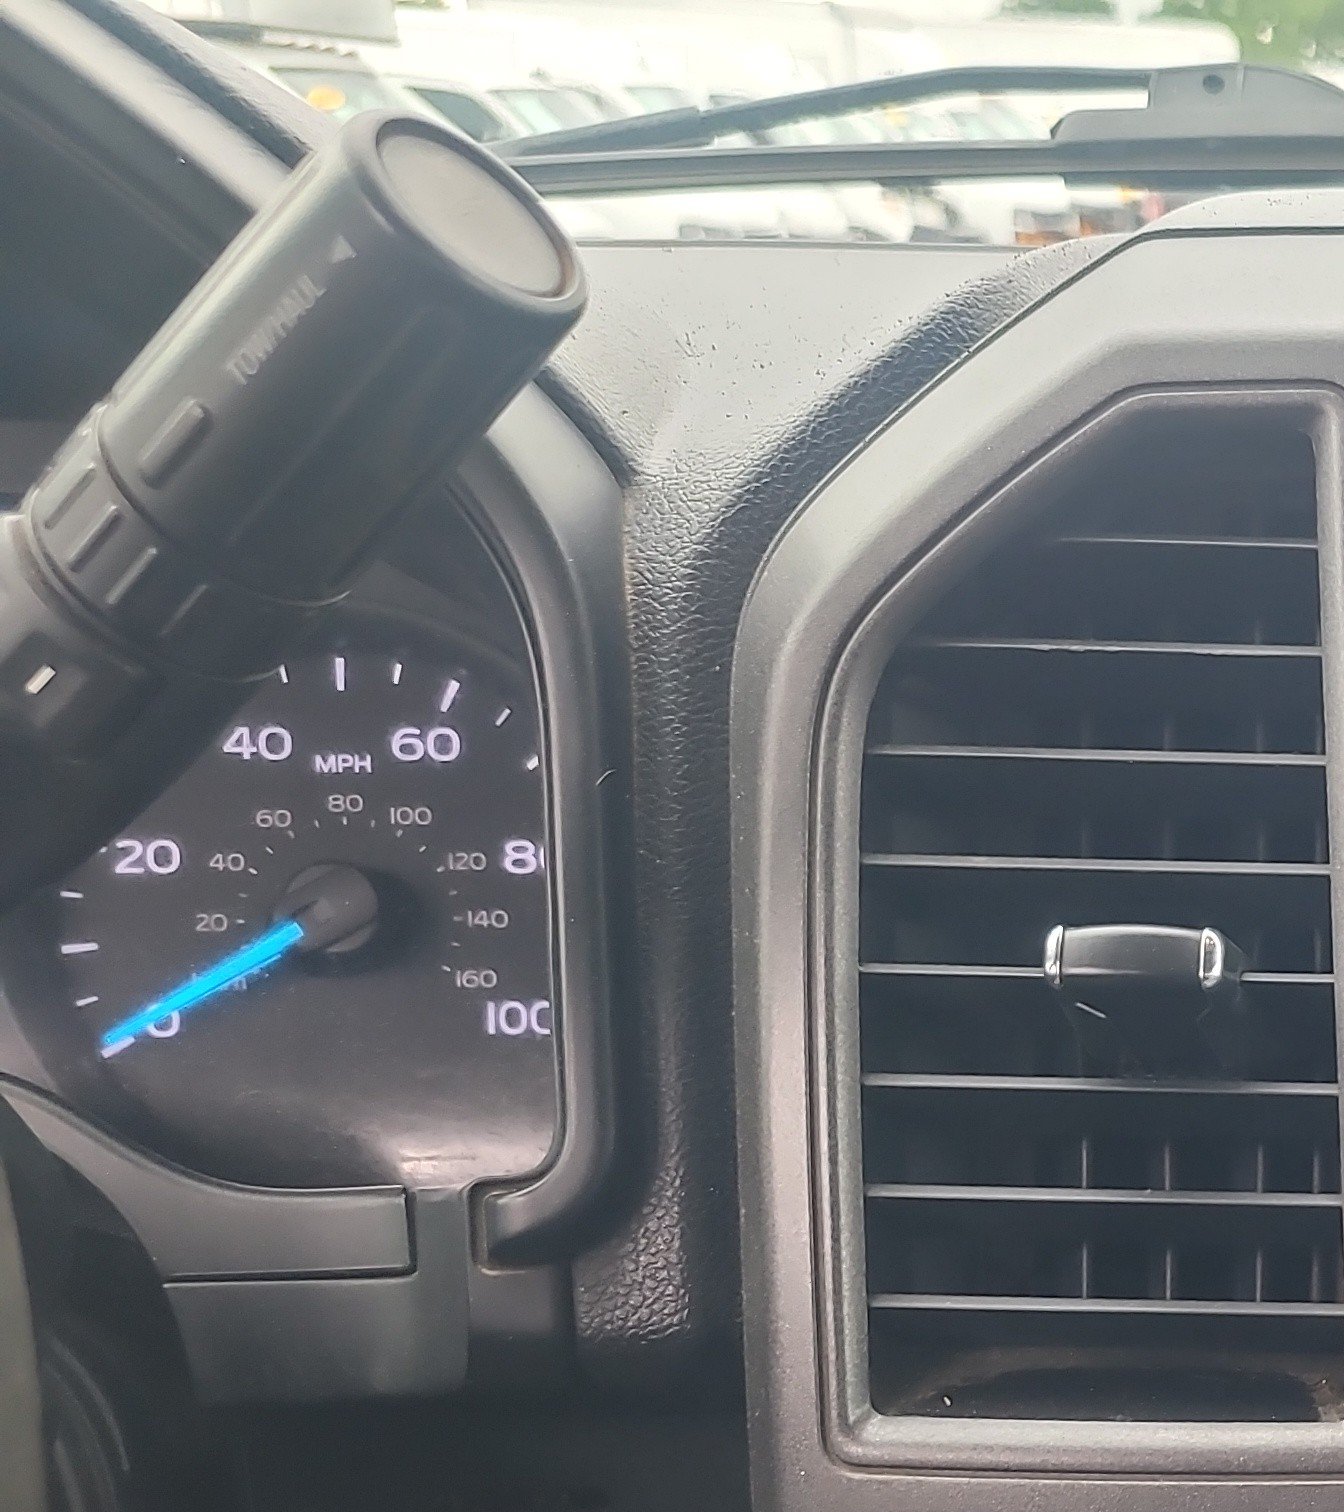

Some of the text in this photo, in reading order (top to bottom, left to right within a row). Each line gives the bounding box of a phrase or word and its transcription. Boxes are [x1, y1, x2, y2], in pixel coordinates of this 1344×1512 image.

[222, 726, 293, 762] 40
[390, 726, 462, 763] 60
[314, 753, 373, 774] MPH
[327, 794, 364, 813] 80
[255, 809, 293, 829] 60
[389, 806, 432, 826] 100
[114, 839, 181, 875] 20
[208, 852, 246, 872] 40
[447, 852, 487, 872] 120
[503, 839, 545, 875] 8
[195, 913, 229, 932] 20
[466, 910, 510, 930] 140
[455, 969, 498, 989] 160
